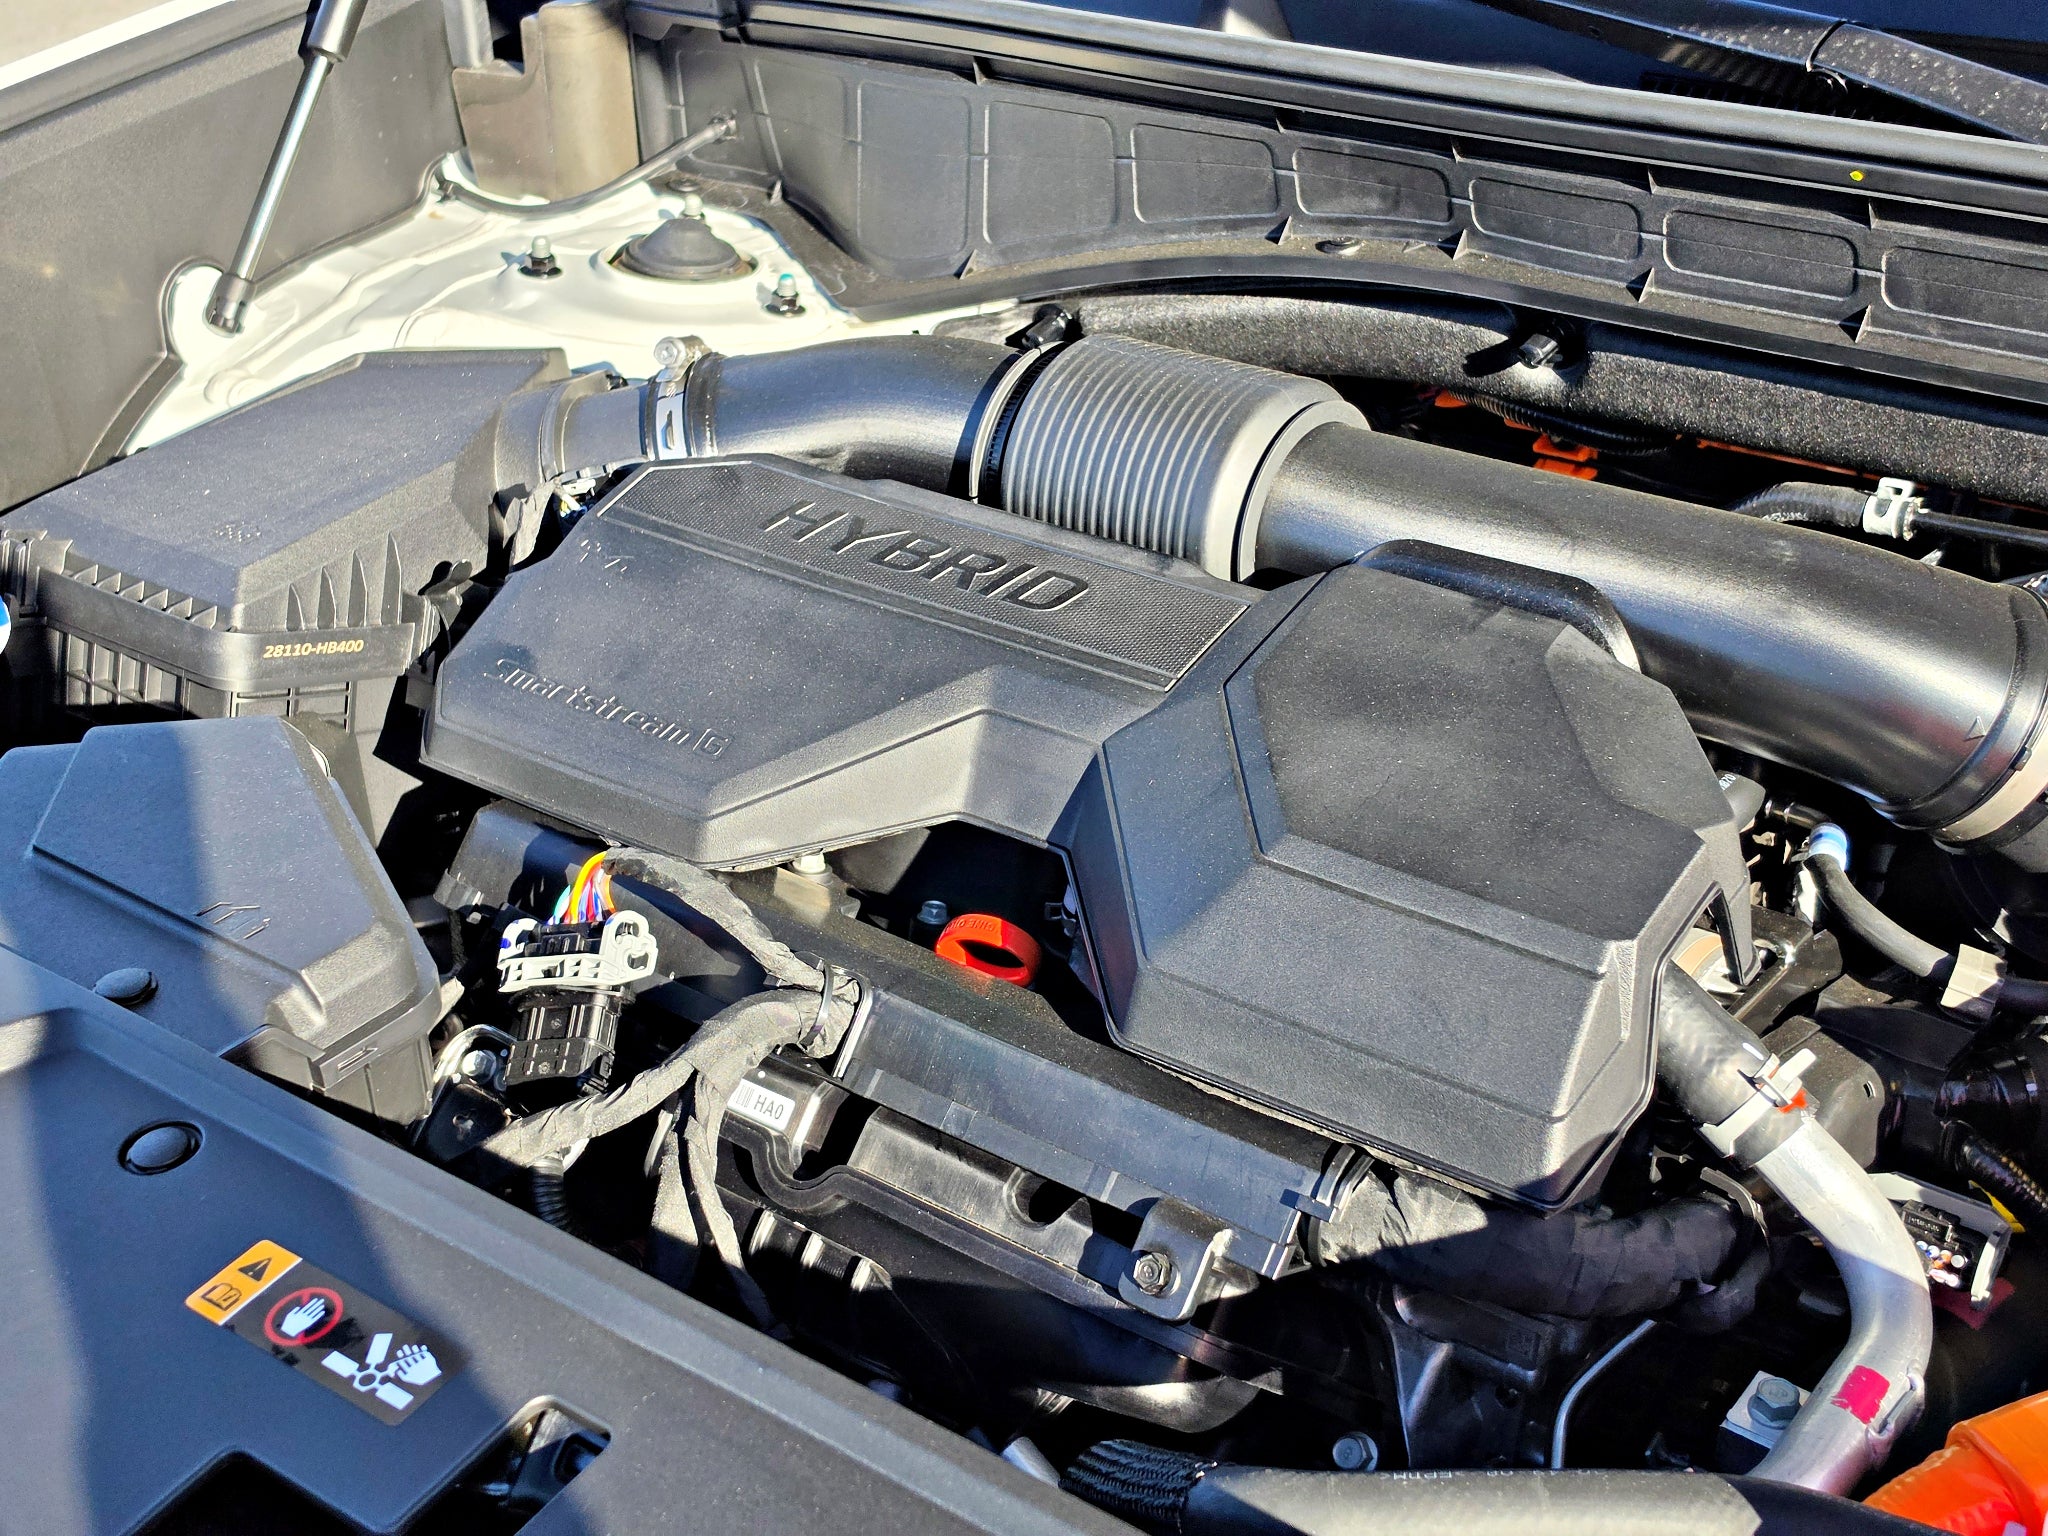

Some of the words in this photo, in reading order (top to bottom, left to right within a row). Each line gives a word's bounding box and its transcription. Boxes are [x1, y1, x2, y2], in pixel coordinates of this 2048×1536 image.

[758, 500, 1088, 612] HYBRID
[263, 640, 364, 659] 28110-HB400
[484, 658, 691, 745] Smartstream
